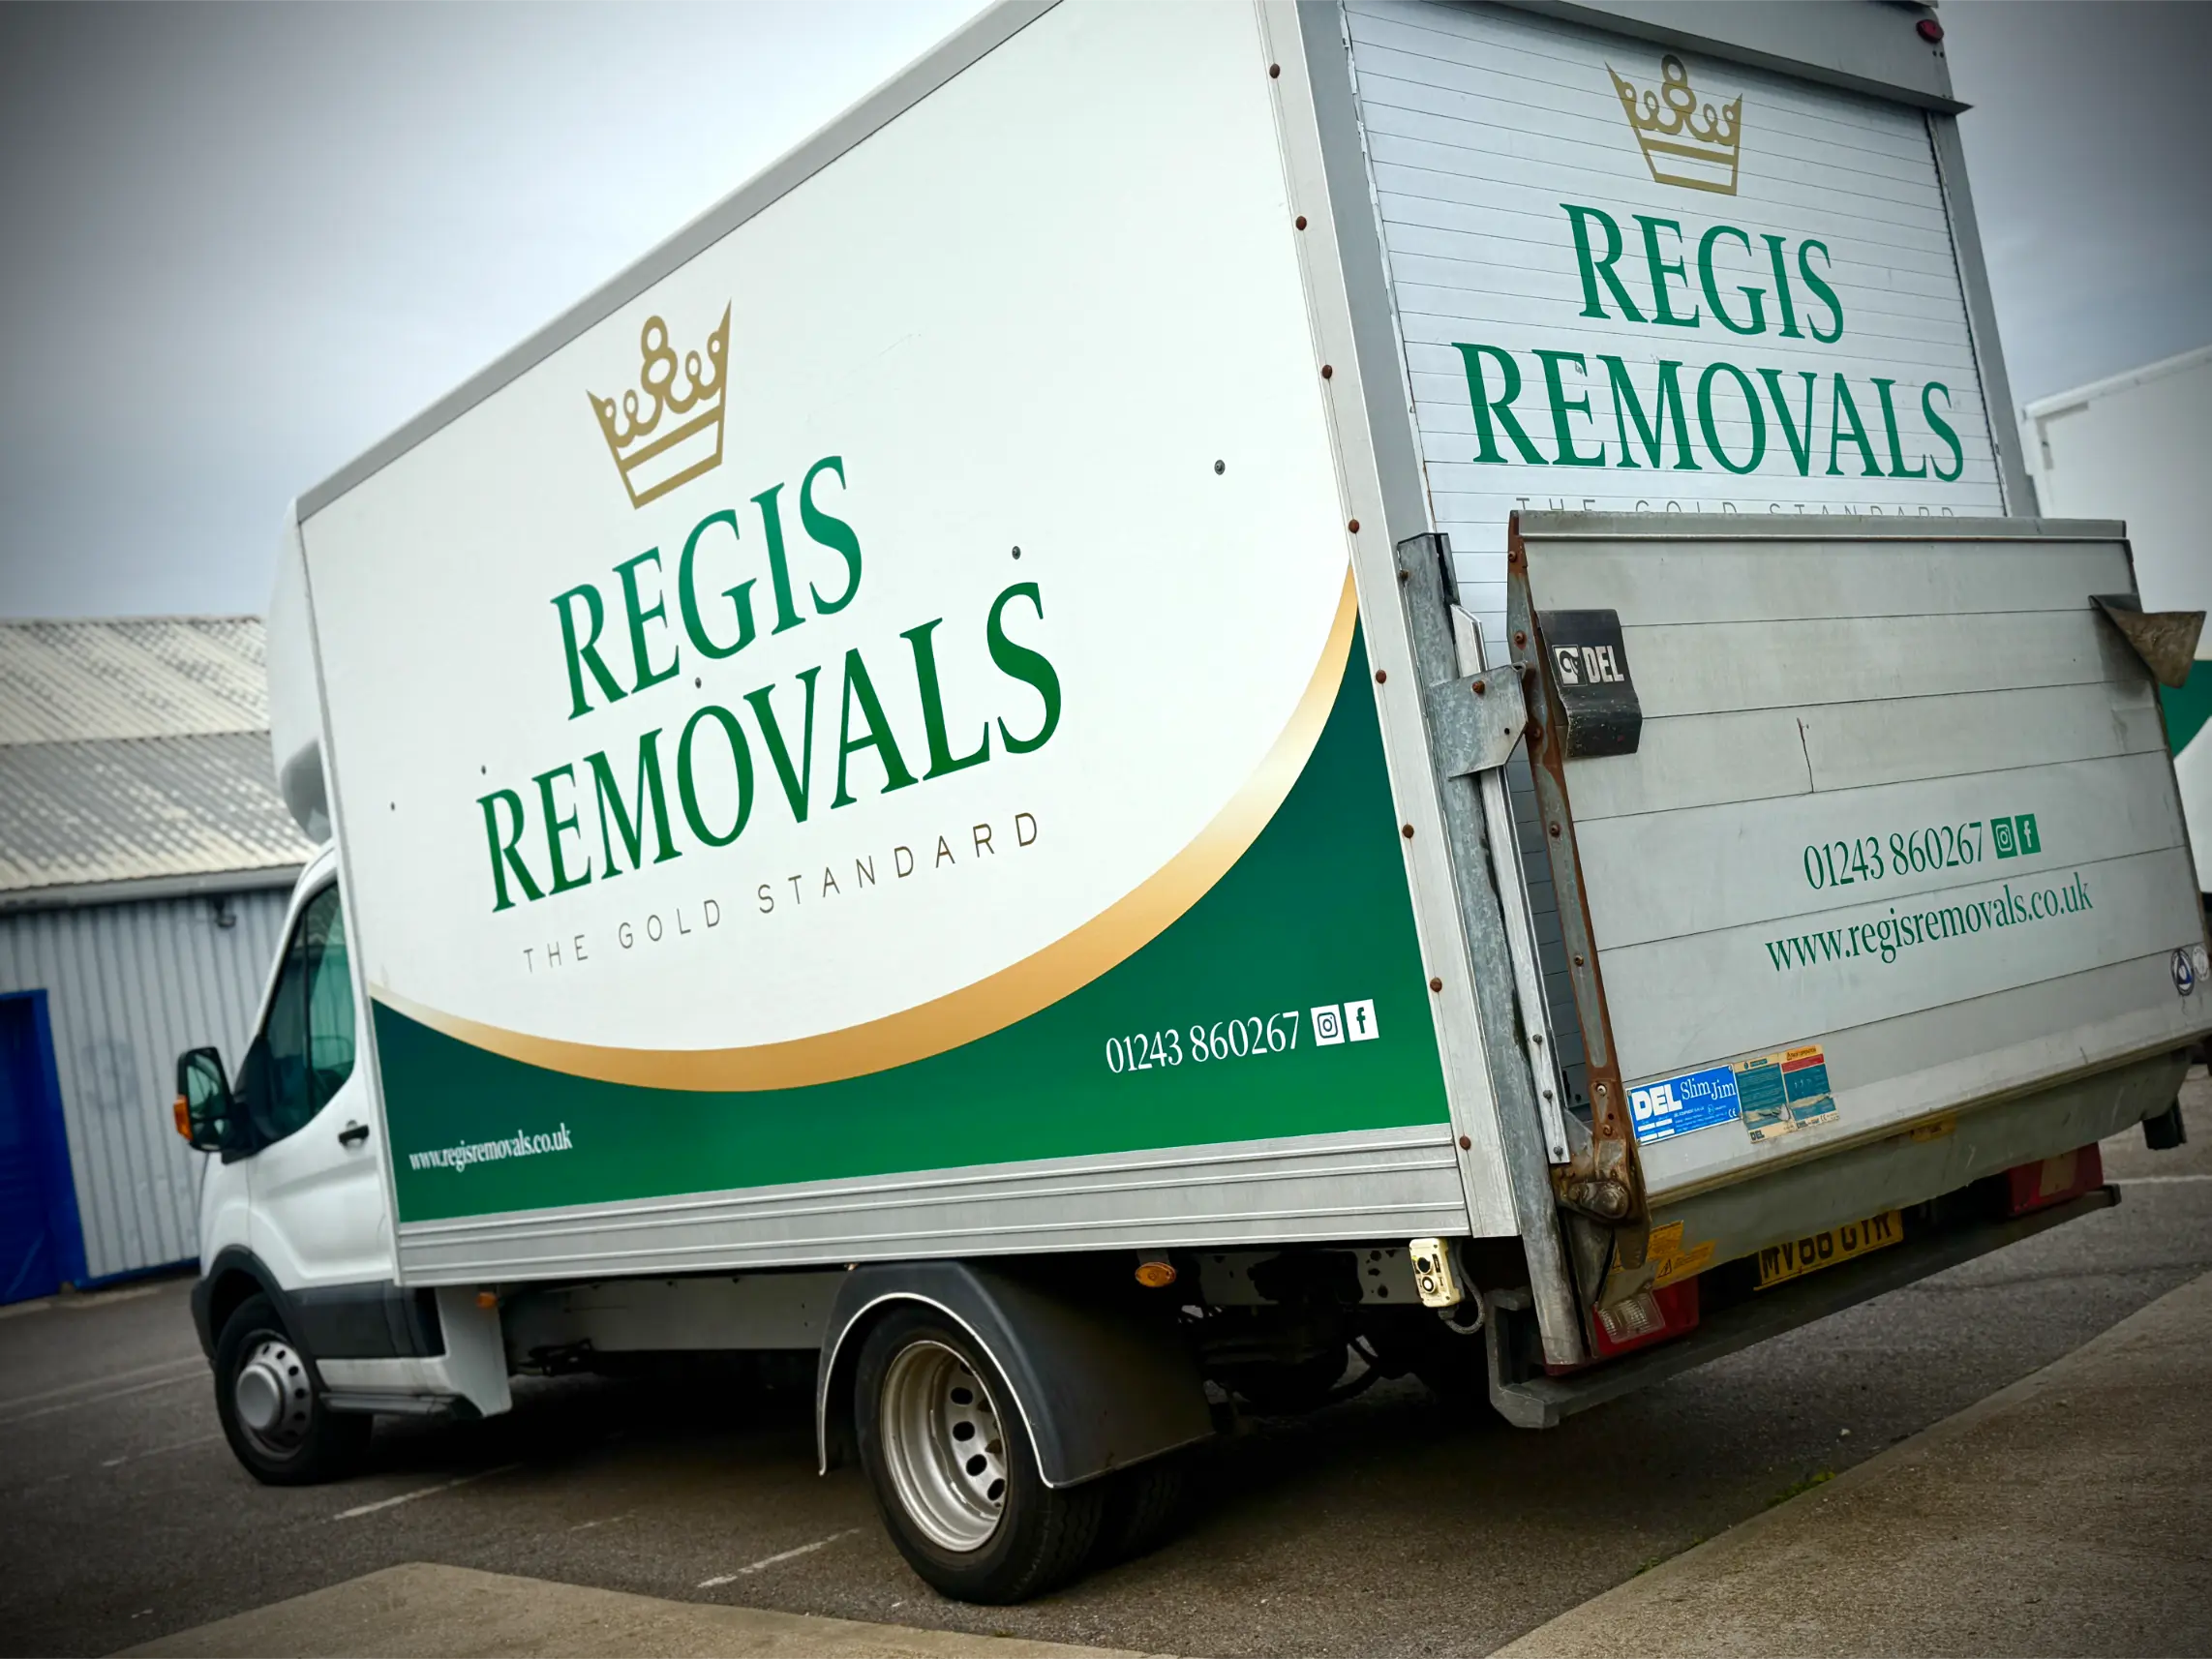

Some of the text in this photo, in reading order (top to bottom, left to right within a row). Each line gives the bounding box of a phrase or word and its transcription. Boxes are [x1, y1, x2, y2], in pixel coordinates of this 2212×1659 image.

[1560, 203, 1843, 345] REGIS
[1452, 342, 1964, 483] REMOVALS
[550, 455, 863, 720] REGIS
[1581, 645, 1625, 683] DEL
[475, 582, 1062, 913] REMOVALS
[523, 811, 1038, 973] THE GOLD STANDARD
[1803, 835, 1885, 890] 01243
[1889, 821, 1984, 876] 860267
[1765, 871, 2093, 972] www.regisremovals.co.uk
[1106, 1028, 1184, 1073] 01243
[1189, 1010, 1299, 1063] 860267
[409, 1122, 573, 1173] www.regisremovals.co.uk
[1631, 1083, 1682, 1121] DEL
[1680, 1077, 1712, 1101] Slim
[1711, 1079, 1737, 1101] Jim
